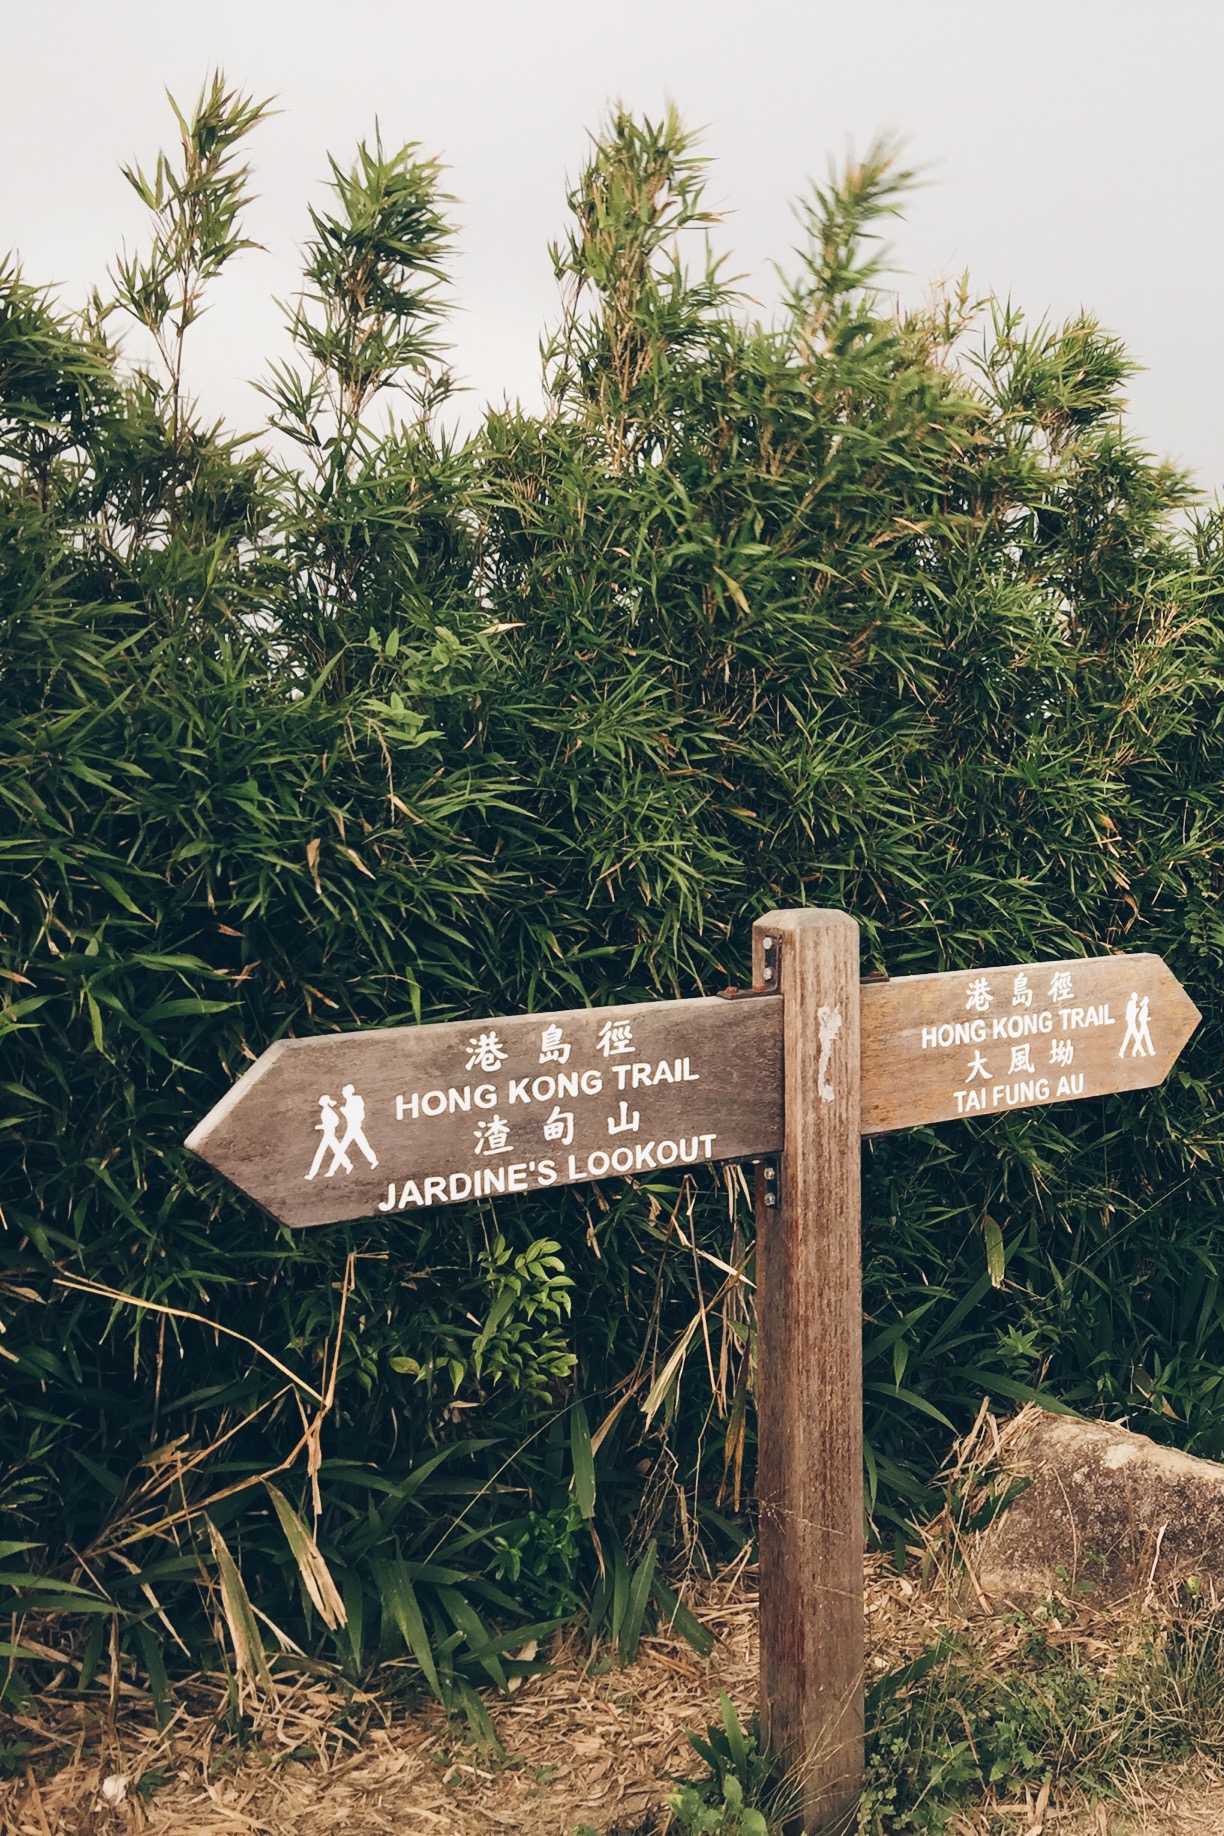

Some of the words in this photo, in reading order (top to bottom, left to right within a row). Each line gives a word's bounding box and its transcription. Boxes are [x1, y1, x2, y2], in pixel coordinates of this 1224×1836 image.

[965, 971, 1076, 1011] 港島徑
[465, 1019, 637, 1072] 港島徑
[922, 1020, 986, 1049] HONG
[993, 1012, 1053, 1039] KONG
[1059, 1004, 1115, 1030] TRAIL
[965, 1038, 1074, 1083] 大風坳
[395, 1084, 498, 1121] HONG
[509, 1070, 603, 1105] KONG
[612, 1057, 700, 1090] TRAIL
[953, 1088, 986, 1113] TAI
[993, 1079, 1050, 1106] FUNG
[1056, 1073, 1084, 1096] AU
[474, 1101, 640, 1156] 渣甸山
[378, 1160, 558, 1211] JARDINE'S
[568, 1134, 718, 1181] LOOKOUT
